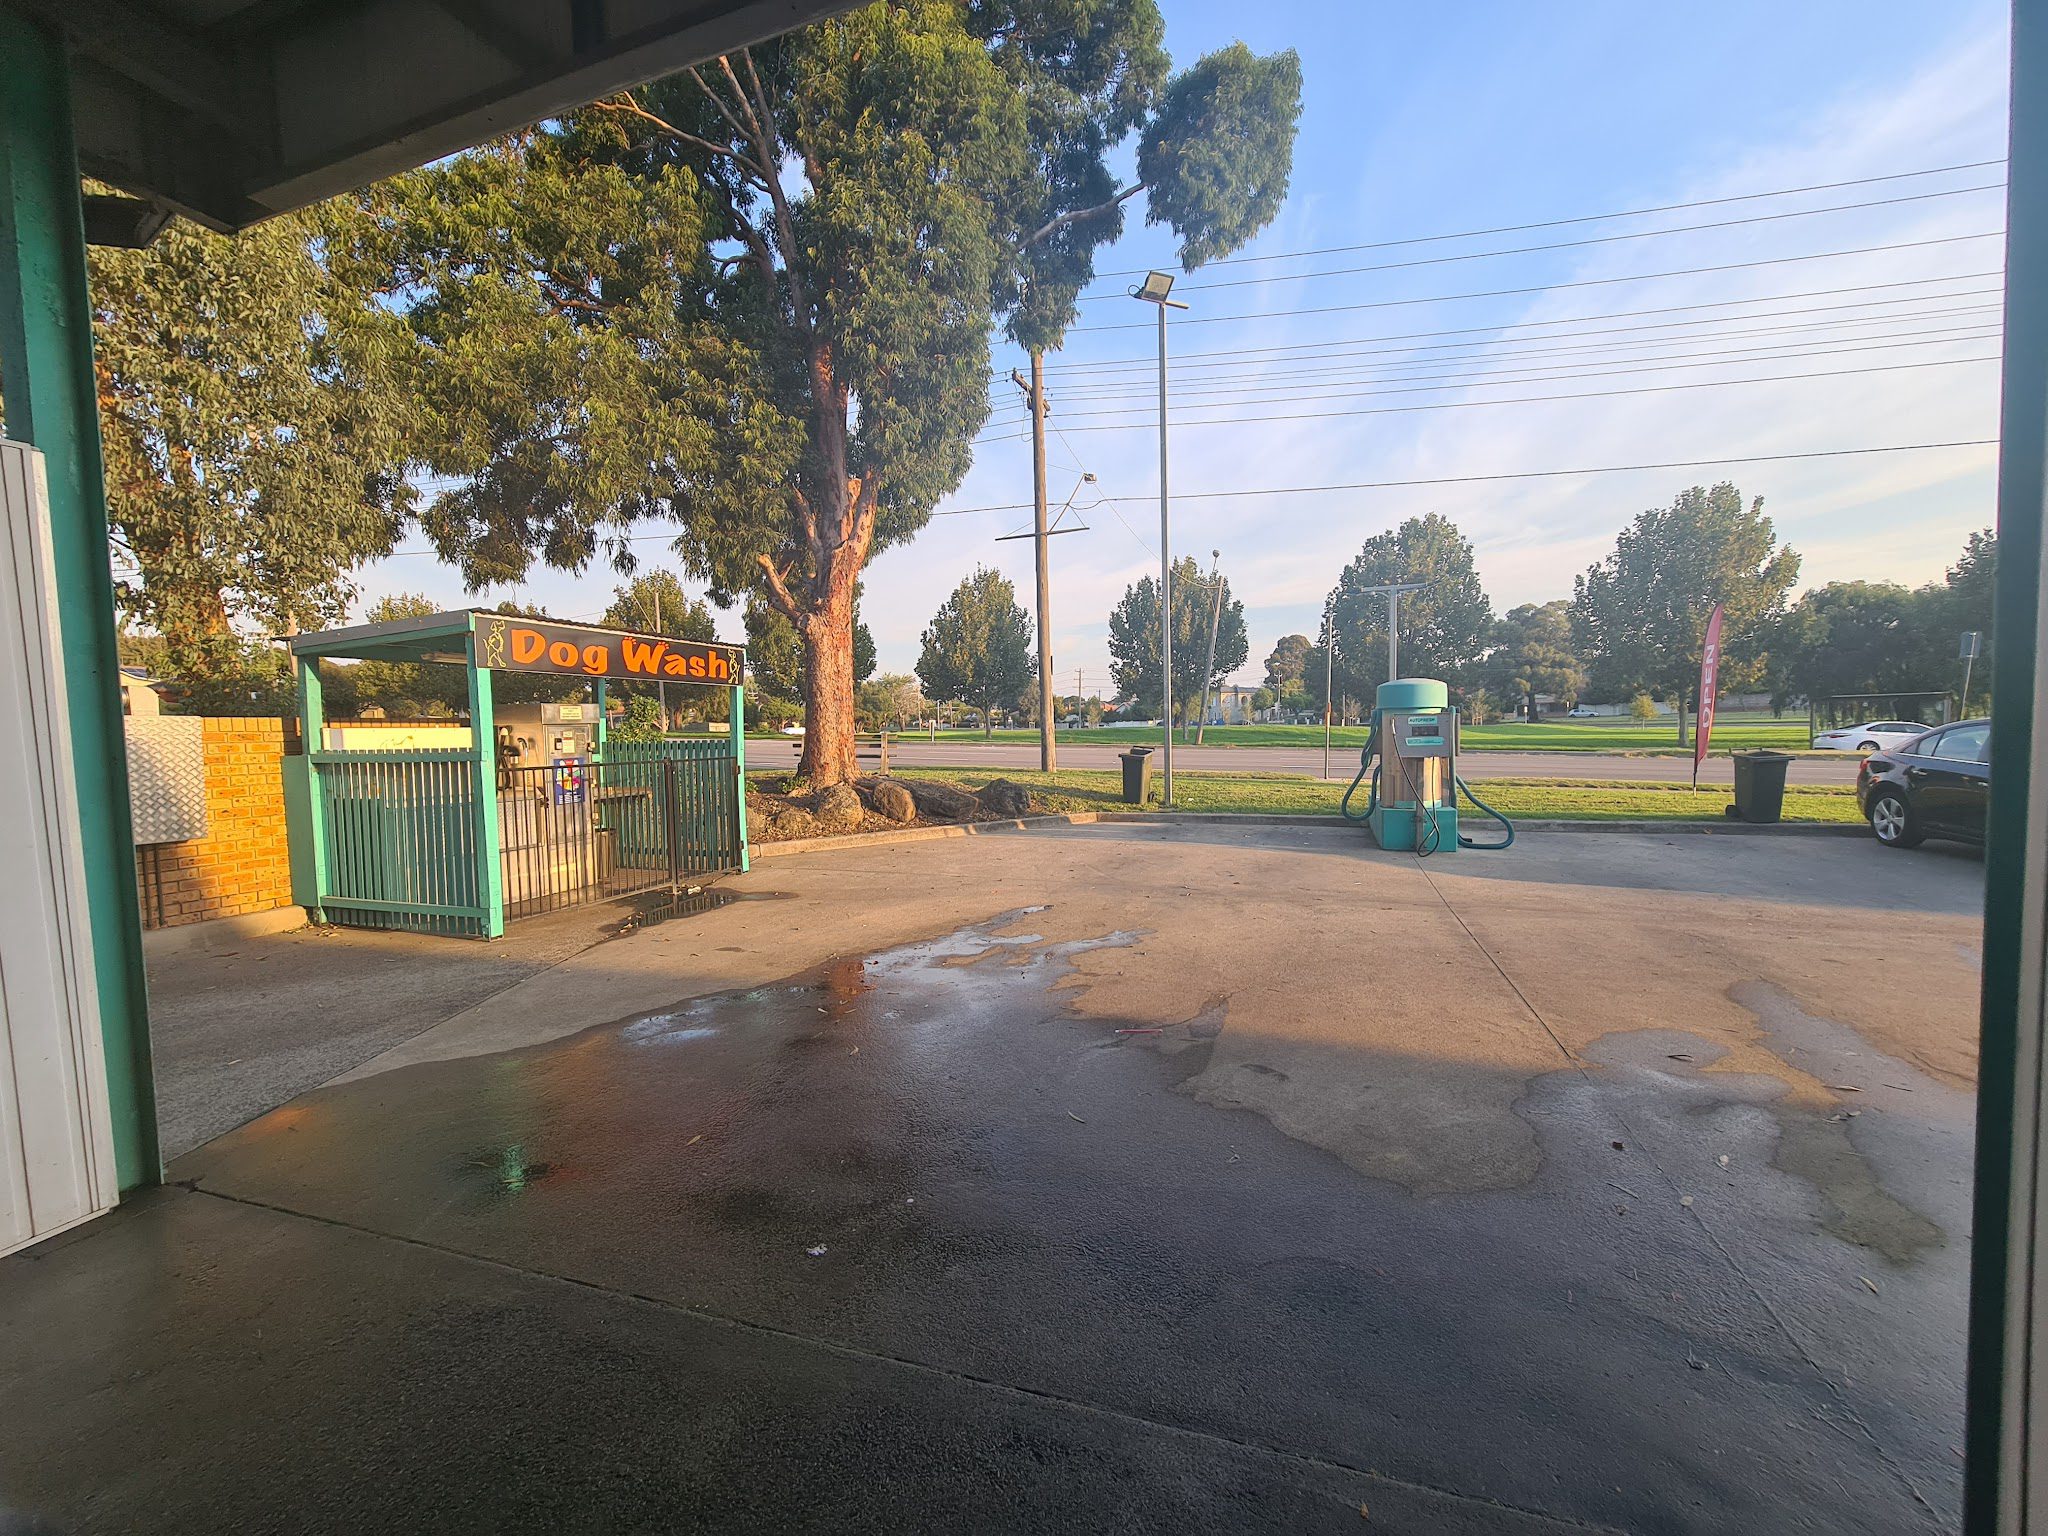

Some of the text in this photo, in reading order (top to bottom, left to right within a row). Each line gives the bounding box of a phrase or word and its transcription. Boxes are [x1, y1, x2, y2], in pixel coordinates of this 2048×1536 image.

[511, 629, 728, 679] Dog Wash
[1702, 644, 1714, 728] OPEN
